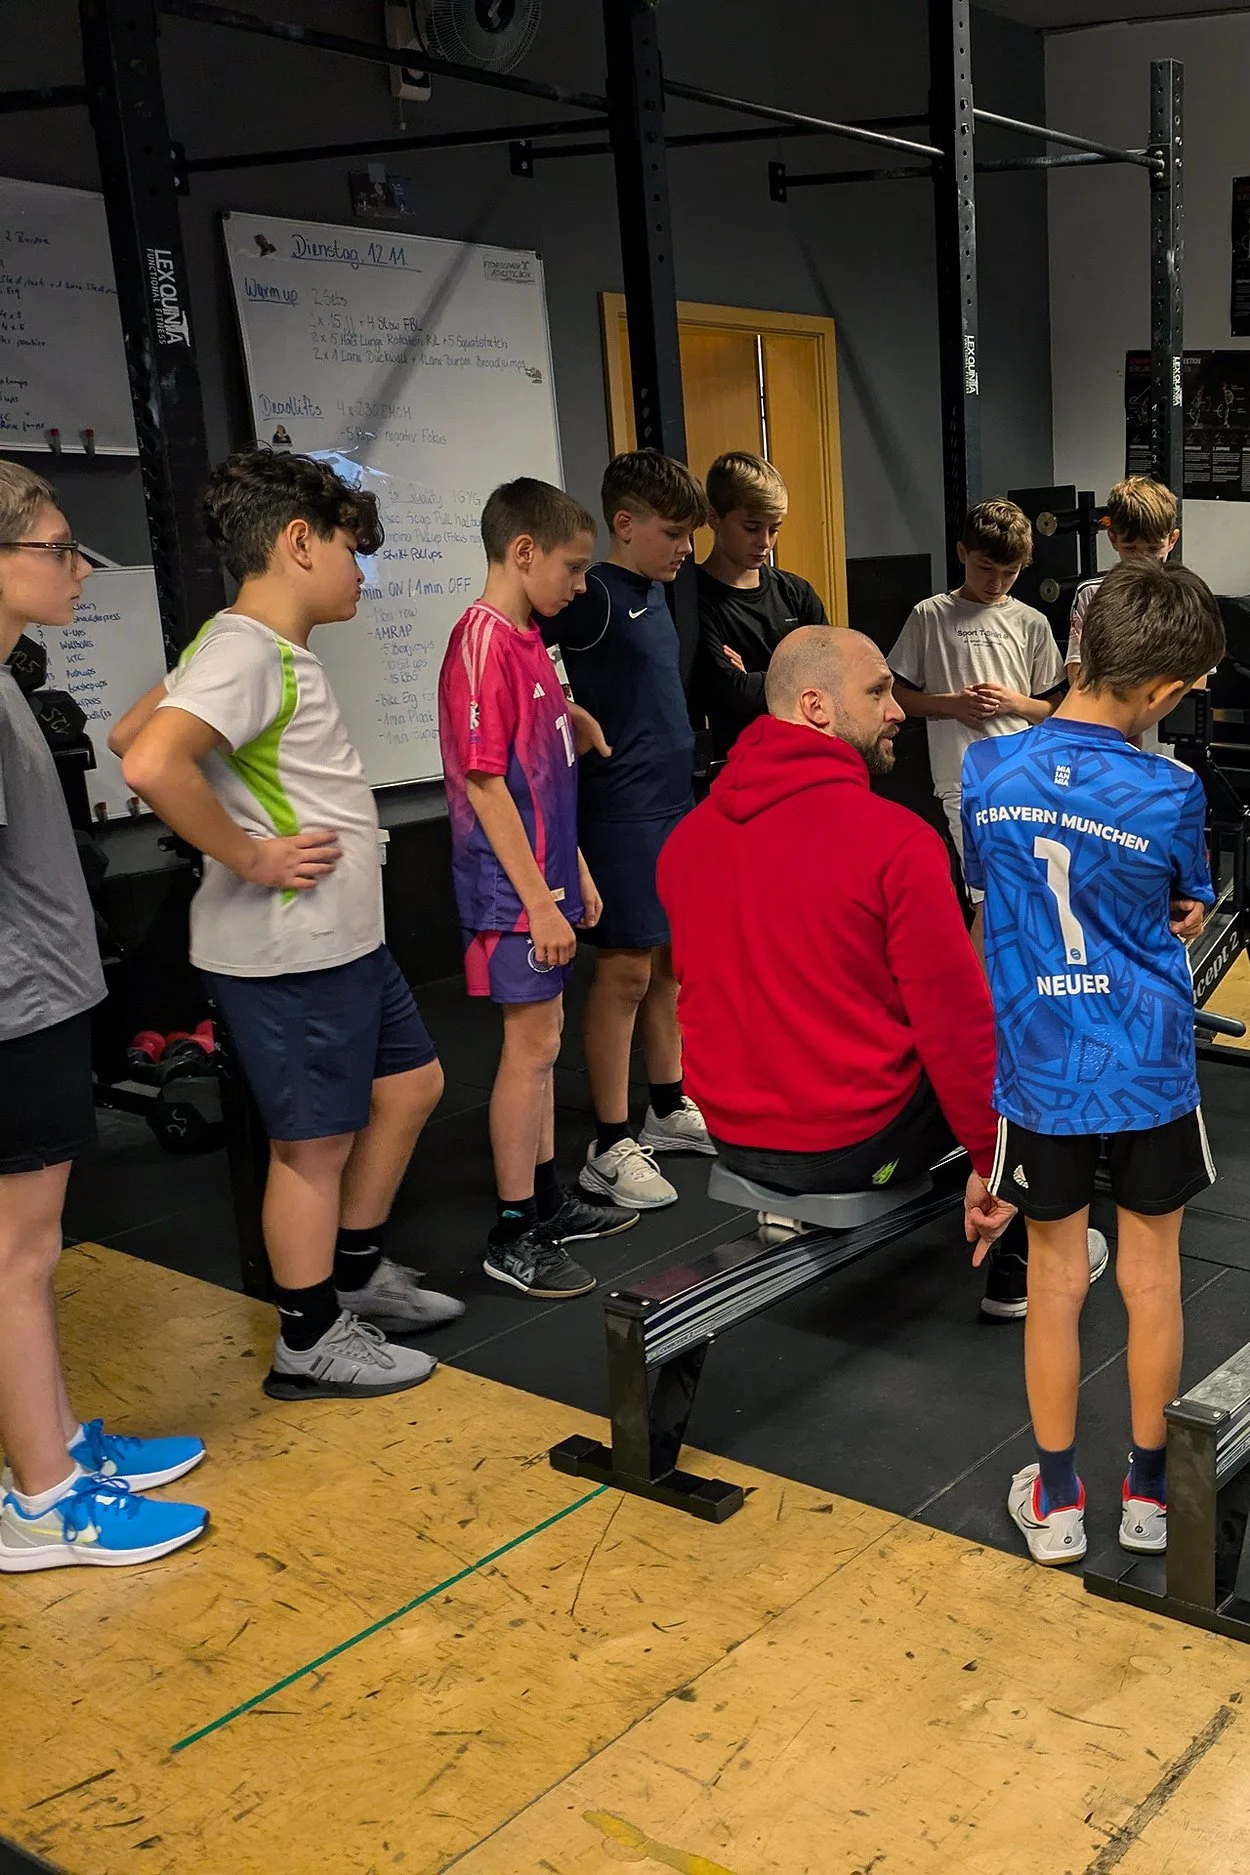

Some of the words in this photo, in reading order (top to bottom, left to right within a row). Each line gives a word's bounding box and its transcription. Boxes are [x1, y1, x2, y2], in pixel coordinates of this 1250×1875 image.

[154, 308, 167, 345] FITNESS
[448, 576, 472, 594] OFF
[975, 809, 989, 827] FC
[989, 806, 1058, 825] BAYERN
[1061, 812, 1150, 853] MUNCHEN
[1034, 836, 1088, 966] 1
[1037, 973, 1111, 997] NEUER
